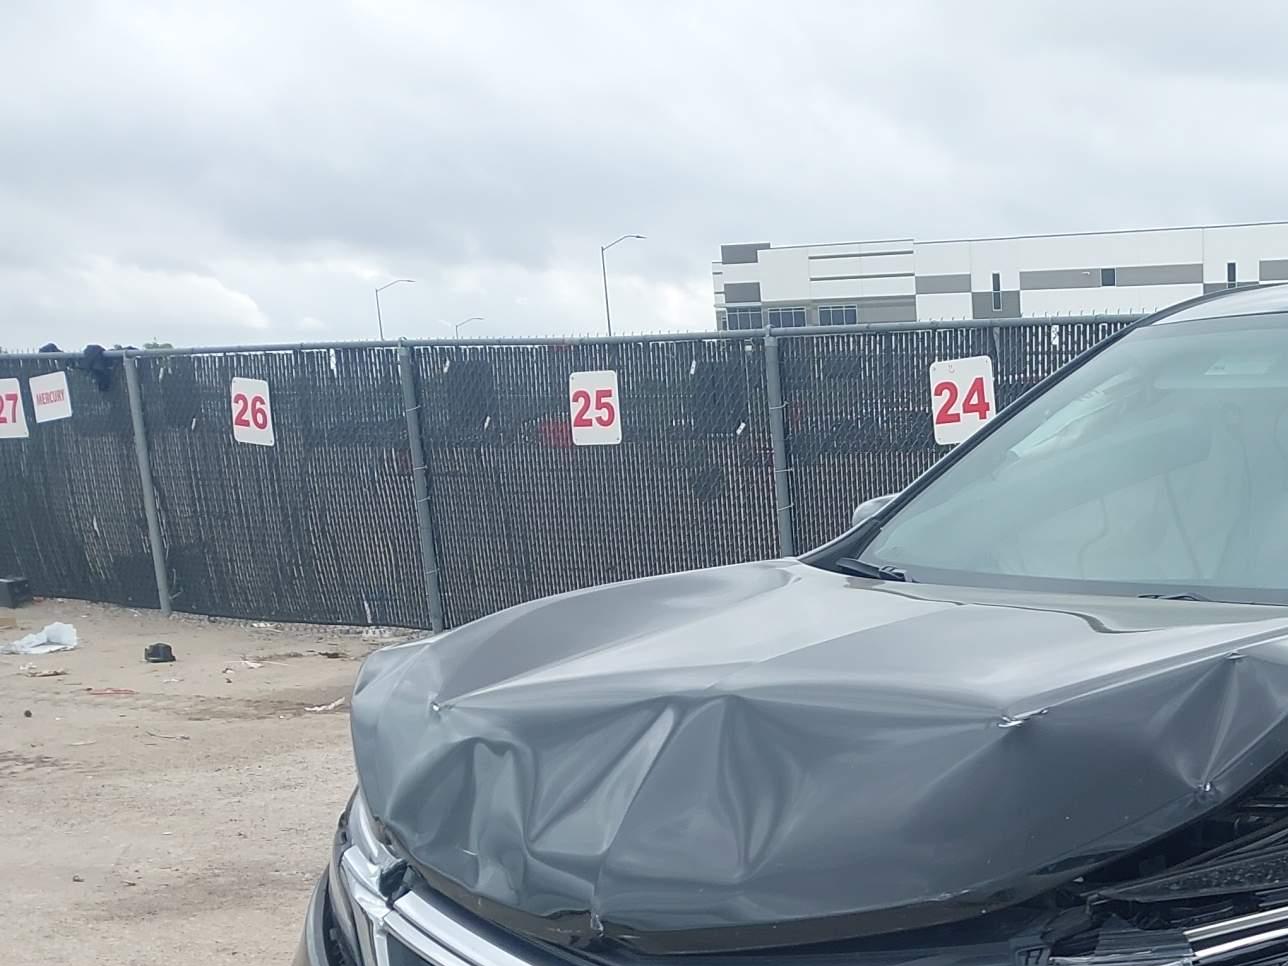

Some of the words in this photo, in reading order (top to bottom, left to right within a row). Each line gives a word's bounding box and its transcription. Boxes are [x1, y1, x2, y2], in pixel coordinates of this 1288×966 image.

[233, 393, 267, 430] 26
[571, 389, 615, 427] 25
[934, 377, 990, 425] 24
